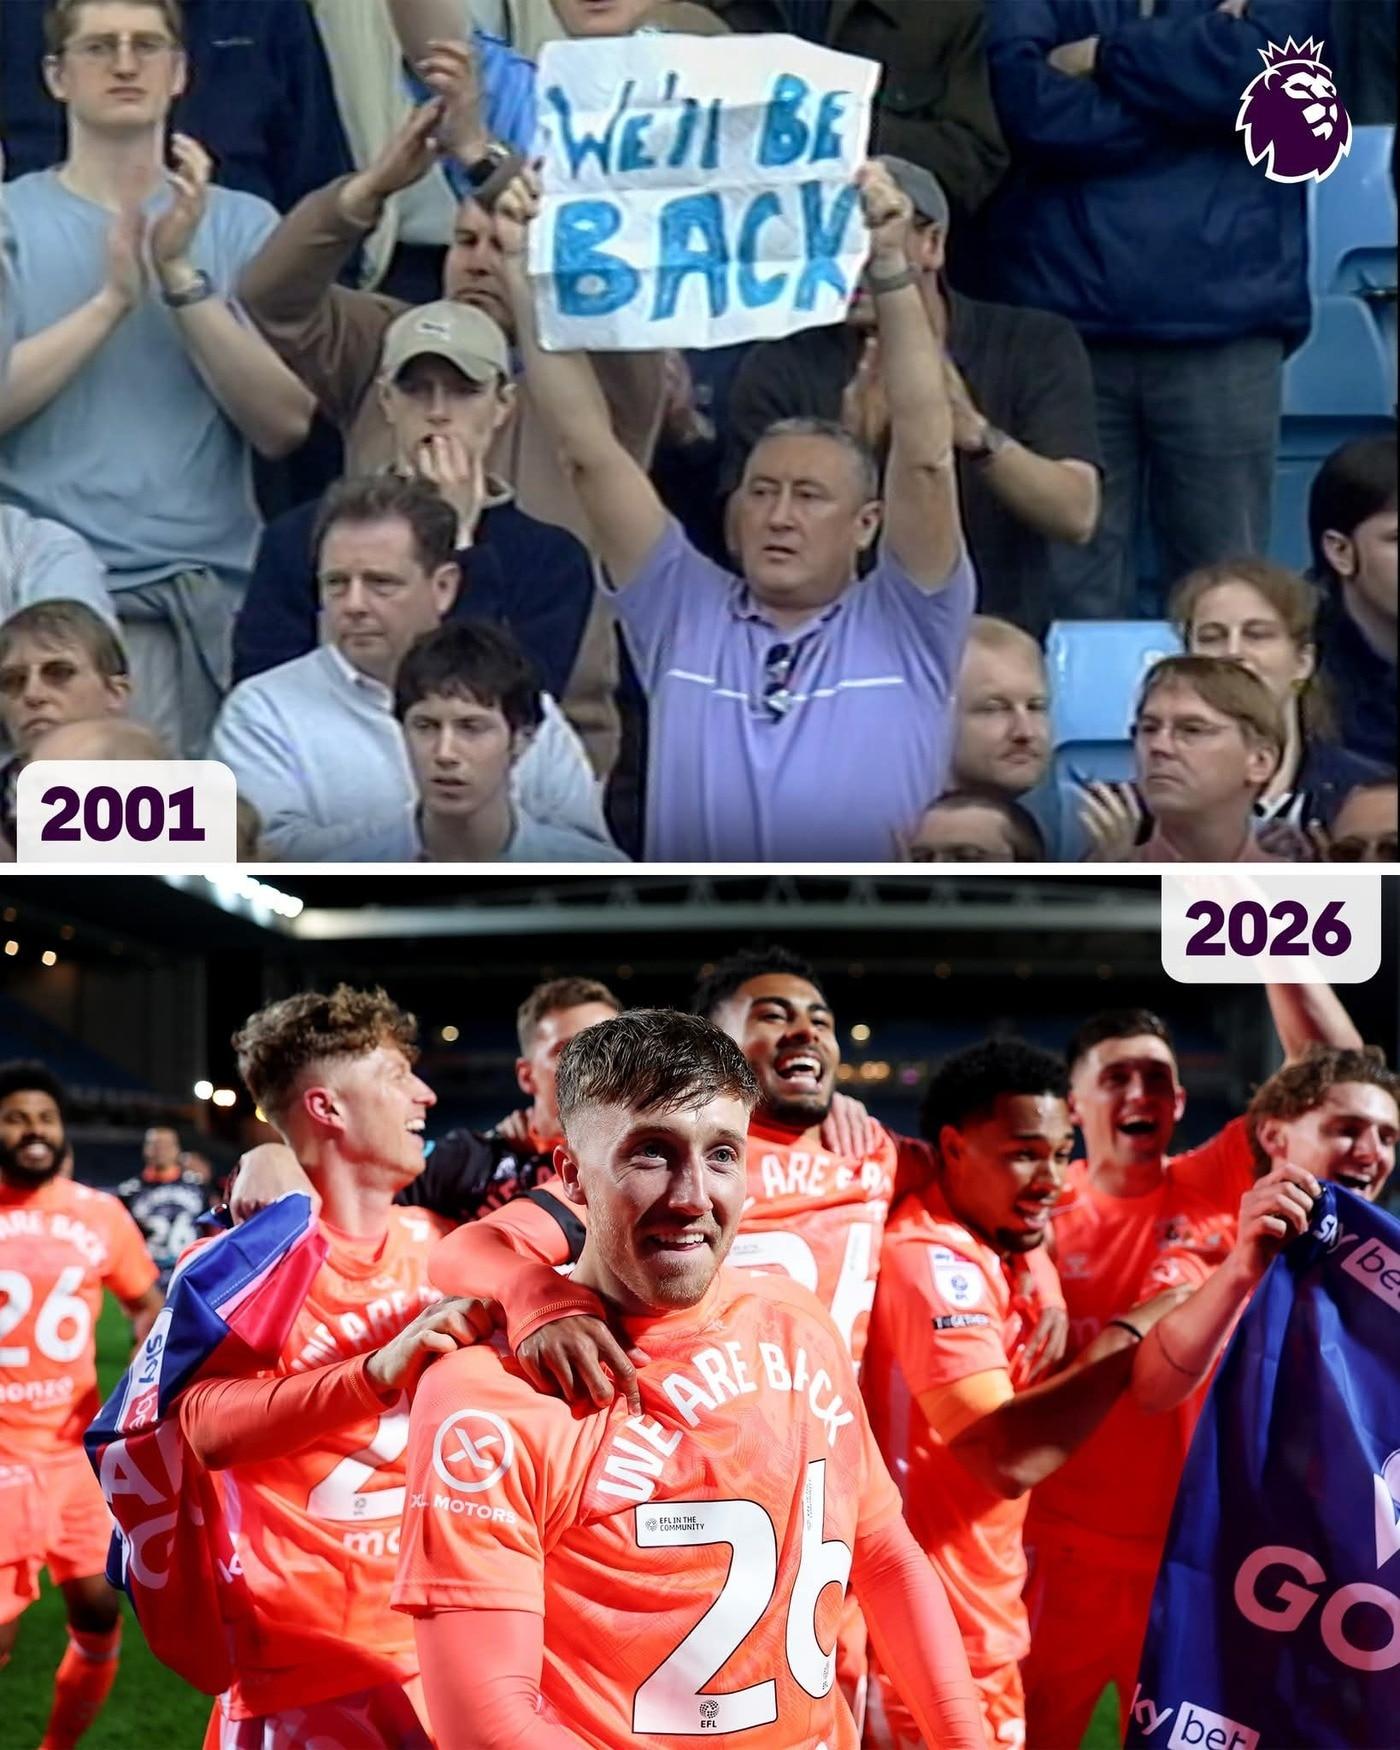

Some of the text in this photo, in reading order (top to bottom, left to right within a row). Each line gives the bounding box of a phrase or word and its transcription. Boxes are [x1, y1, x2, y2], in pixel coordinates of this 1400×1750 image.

[759, 73, 852, 166] BE
[553, 179, 860, 321] BACK
[1355, 1246, 1400, 1300] be
[128, 1391, 158, 1429] be
[596, 1414, 683, 1502] WE
[661, 1340, 757, 1428] ARE
[432, 1493, 518, 1525] MOTORS
[659, 1515, 696, 1524] EFL IN THE
[659, 1523, 705, 1532] COMMUNITY
[632, 1458, 854, 1736] 26
[700, 1719, 718, 1728] EFL
